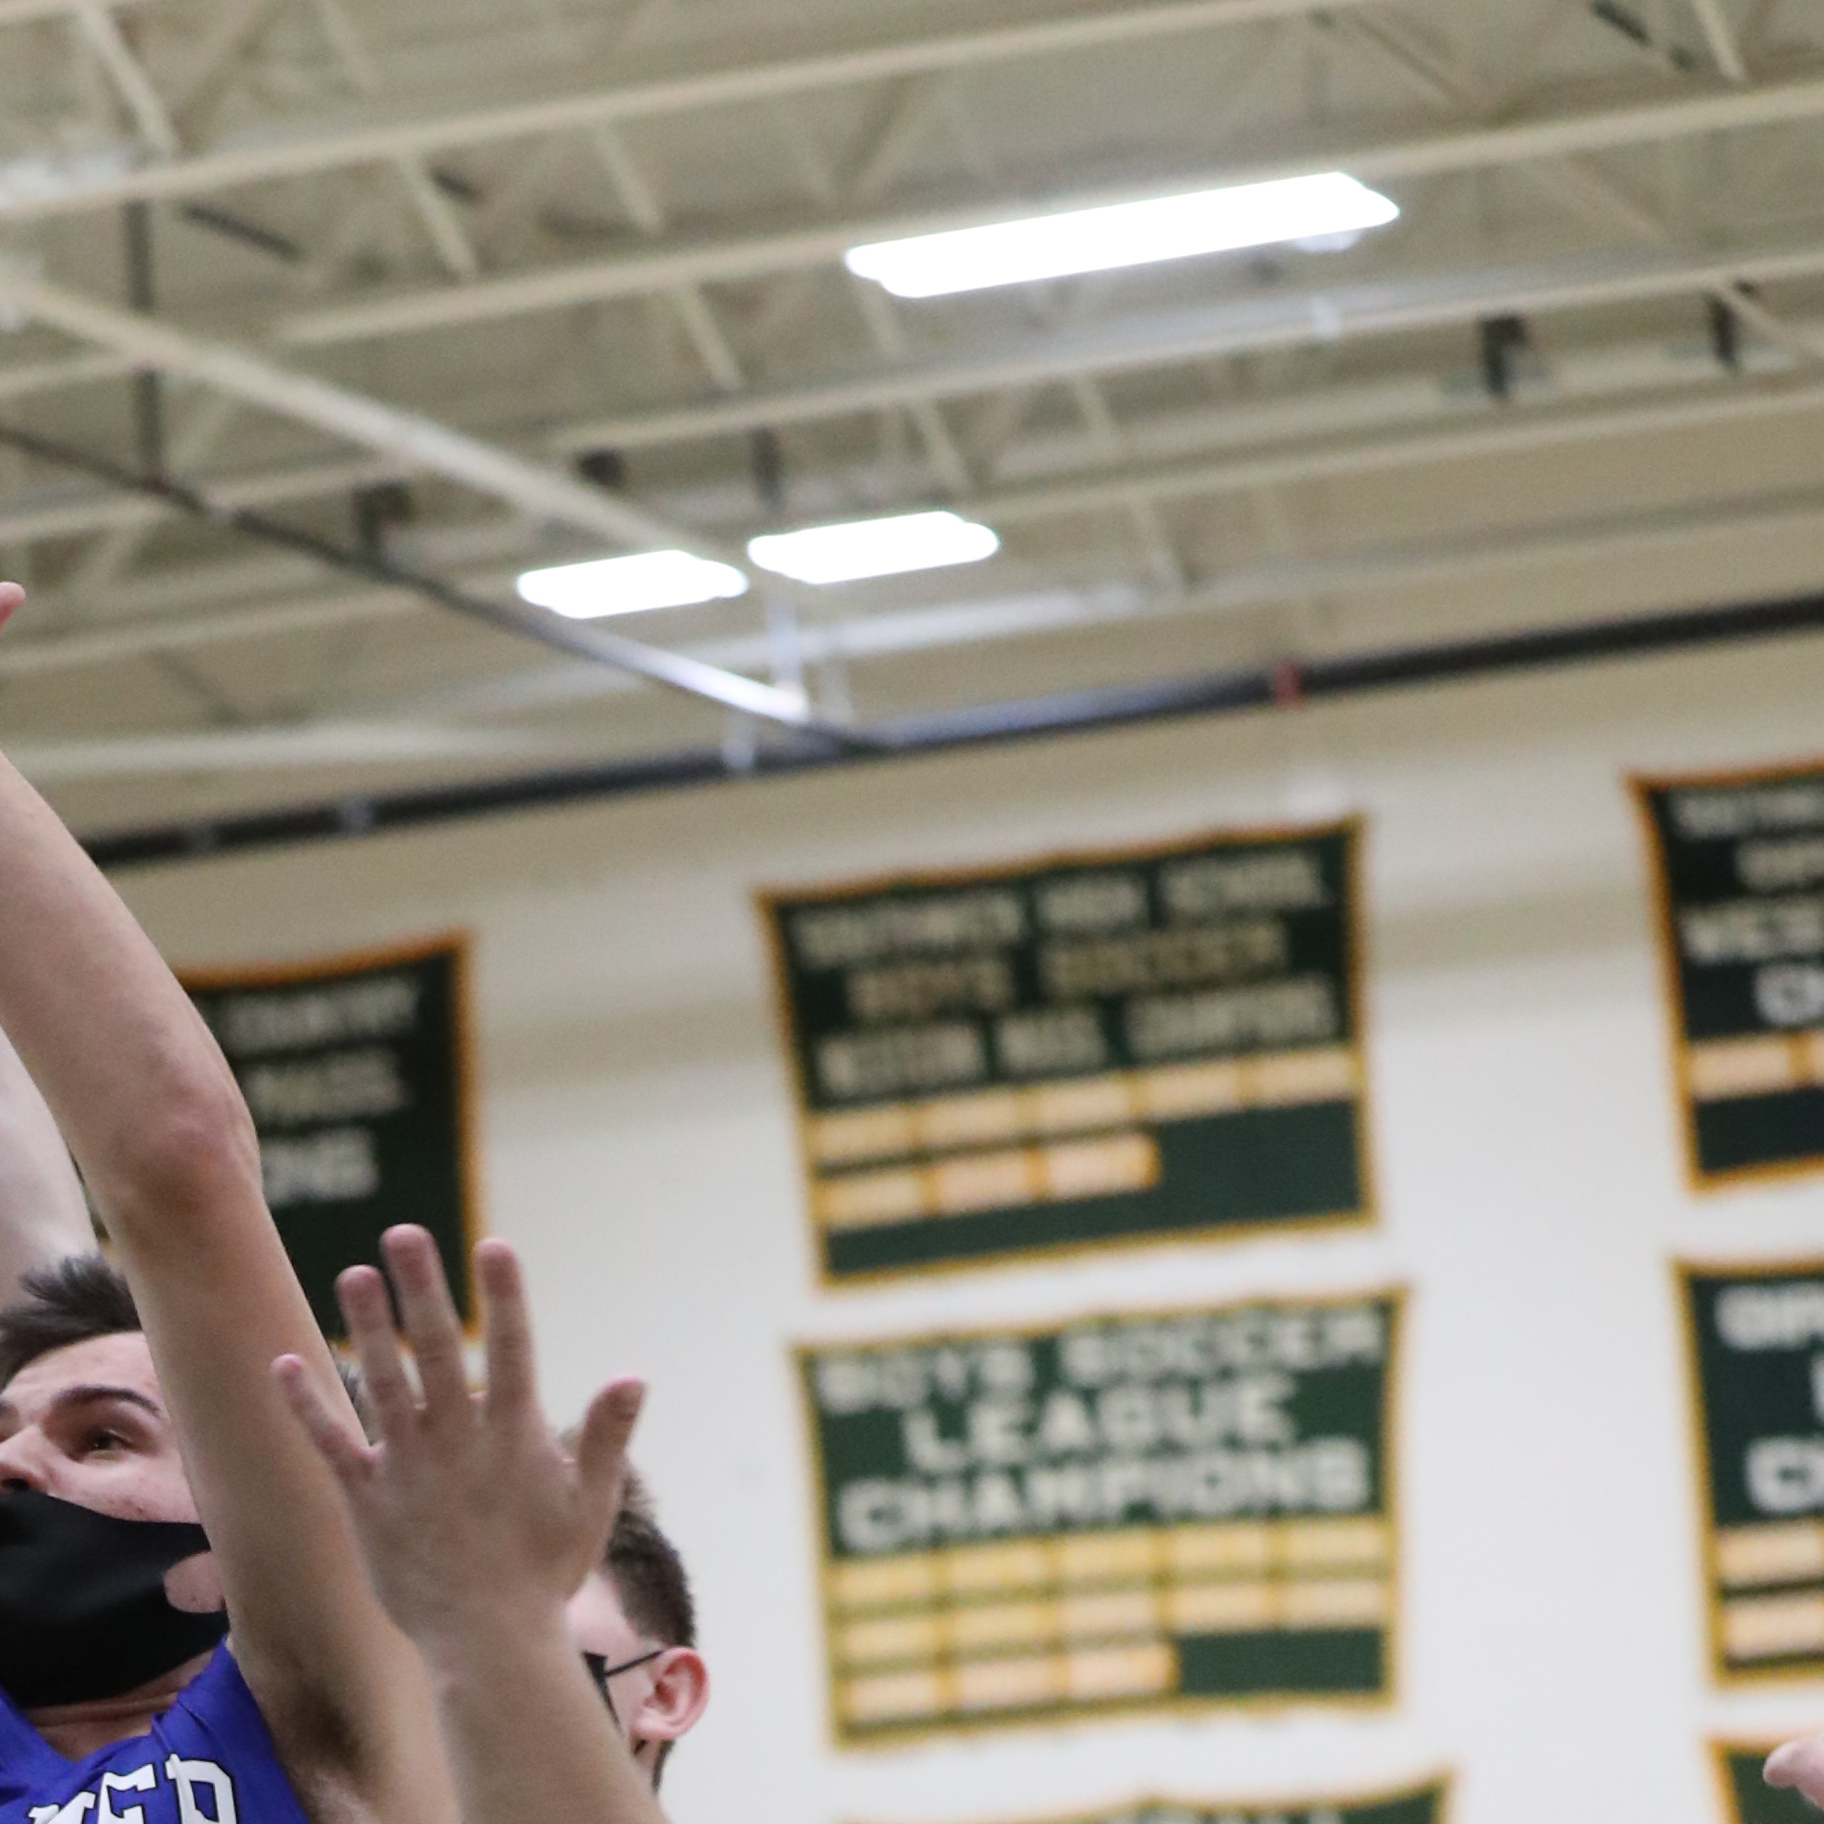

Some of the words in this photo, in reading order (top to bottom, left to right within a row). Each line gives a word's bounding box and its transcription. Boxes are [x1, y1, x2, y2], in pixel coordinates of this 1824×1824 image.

[815, 1345, 1033, 1413] BOYS
[1059, 1308, 1384, 1386] SOCCER
[901, 1374, 1295, 1474] LEAGUE
[839, 1438, 1371, 1550] CHAMPIONS
